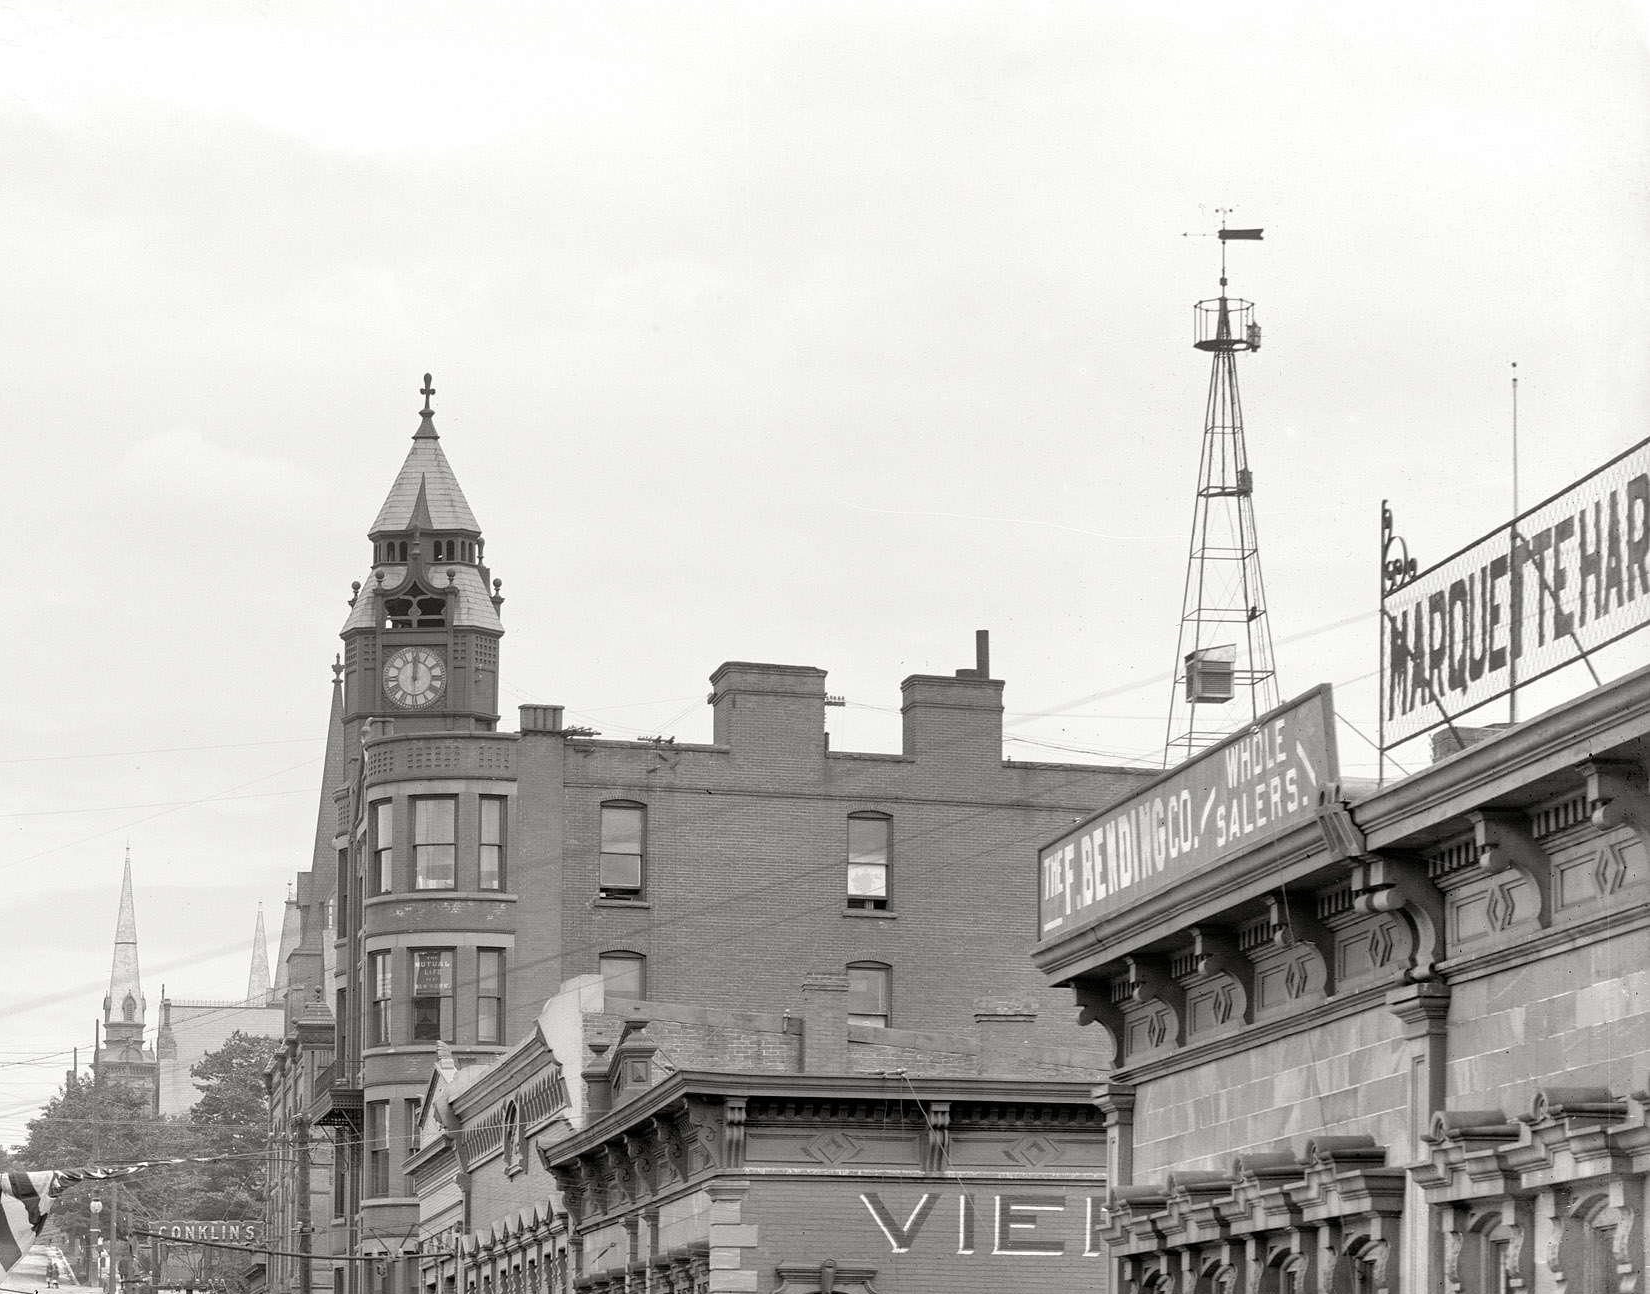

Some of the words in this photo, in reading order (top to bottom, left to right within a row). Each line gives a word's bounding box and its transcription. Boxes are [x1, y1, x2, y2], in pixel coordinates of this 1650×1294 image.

[1224, 719, 1285, 787] WHOLE
[1044, 858, 1063, 900] THE
[1083, 796, 1167, 906] BENDING
[158, 1224, 255, 1240] CONKLIN'S
